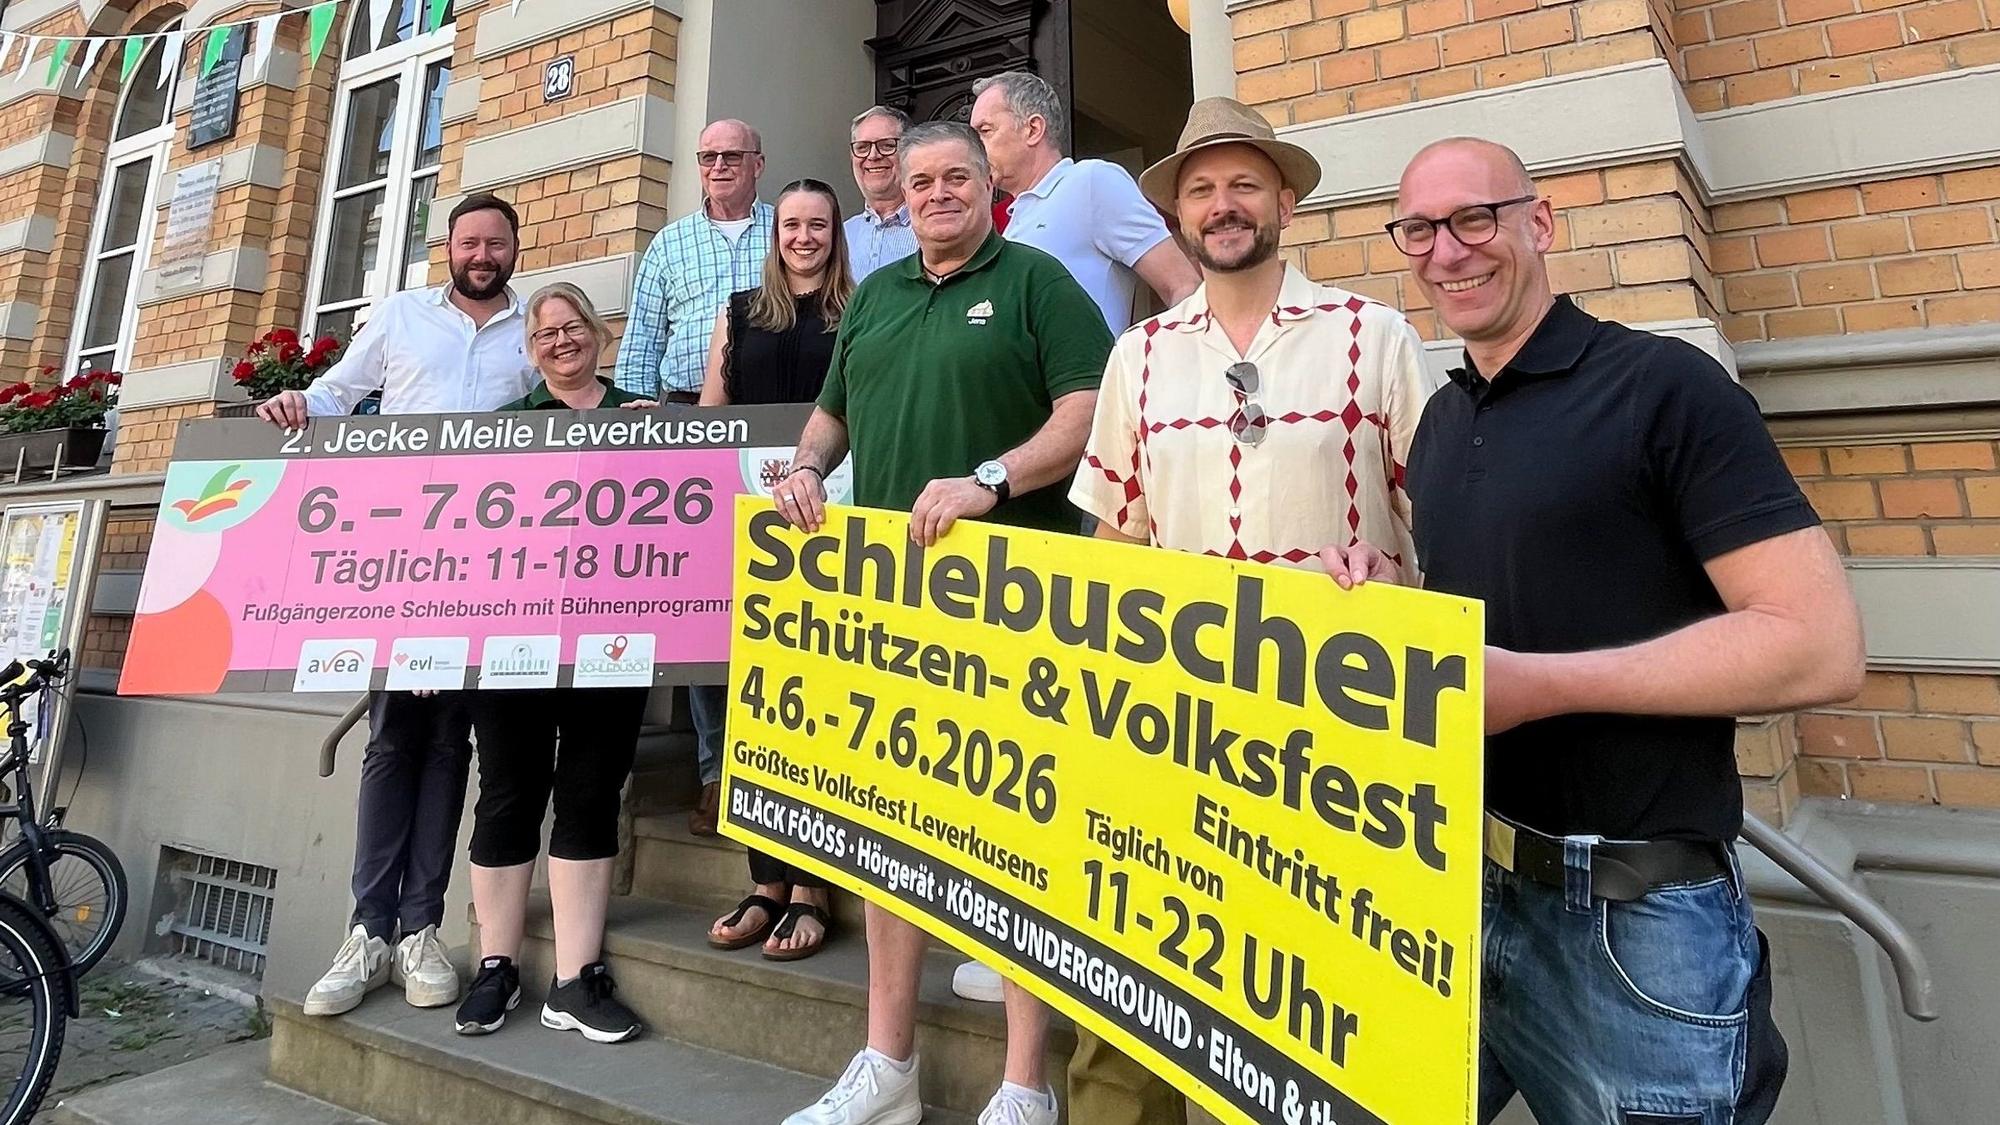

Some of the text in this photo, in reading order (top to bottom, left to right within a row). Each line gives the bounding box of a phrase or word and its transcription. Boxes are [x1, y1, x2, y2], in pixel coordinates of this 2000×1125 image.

[547, 63, 569, 94] 28
[280, 414, 748, 453] 2. Jecke Meile Leverkusen
[422, 477, 713, 530] 7.6.2026
[311, 543, 689, 592] Täglich: 11-18 Uhr
[242, 603, 395, 625] Fußgängerzone
[400, 599, 516, 618] Schlebusch
[522, 598, 555, 616] mit
[747, 509, 1467, 748] Schlebuscher
[308, 655, 361, 673] avea
[409, 656, 433, 671] evl
[742, 593, 1447, 872] Schützen- & Volksfest
[733, 740, 809, 787] Größtes
[813, 764, 906, 825] Volksfest
[911, 802, 1049, 892] Leverkusens
[1085, 808, 1224, 902] Täglich von
[1193, 794, 1454, 998] Eintritt frei!
[732, 787, 785, 834] BLÄCK
[788, 806, 848, 859] FÖÖSS
[856, 836, 936, 902] Hörgerät
[945, 878, 1010, 942] KÖBES
[1013, 912, 1193, 1050] UNDERGROUND
[1209, 1027, 1276, 1114] Elton
[1282, 1079, 1305, 1125] &
[1084, 858, 1225, 992] 11-22
[1242, 932, 1358, 1069] Uhr
